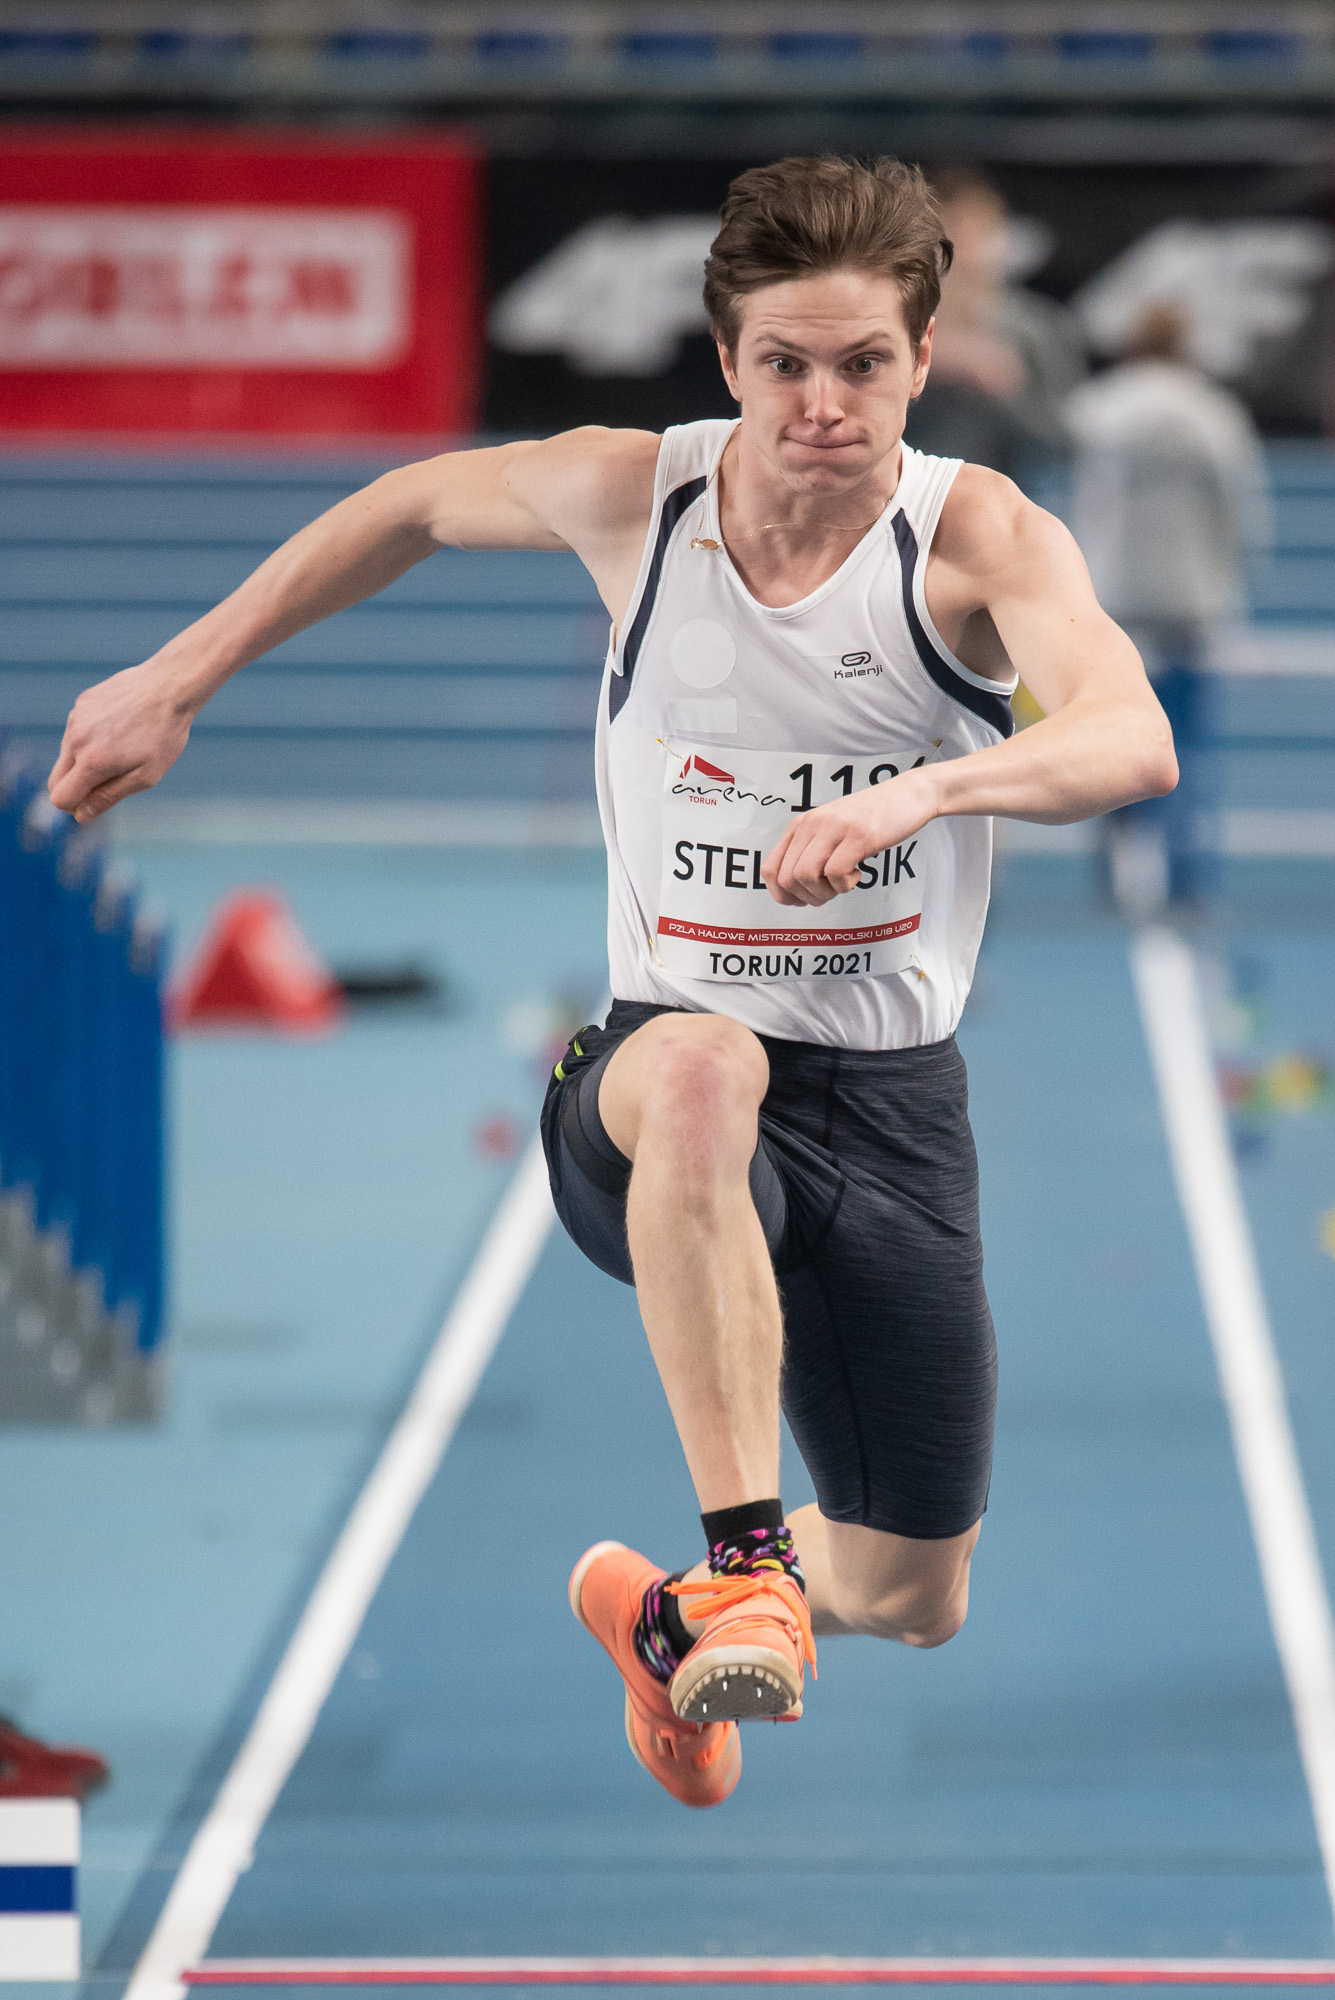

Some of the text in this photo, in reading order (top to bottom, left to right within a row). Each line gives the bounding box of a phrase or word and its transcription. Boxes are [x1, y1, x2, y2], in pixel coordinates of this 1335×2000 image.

[833, 664, 884, 680] Kalenji
[671, 783, 786, 806] arena
[789, 755, 925, 813] 11
[672, 839, 918, 890] STELSIK
[668, 921, 913, 942] PZLA HALOWE MISTRZOSTWA POLSKI U18 U20
[709, 947, 871, 977] TORUŃ 2021
